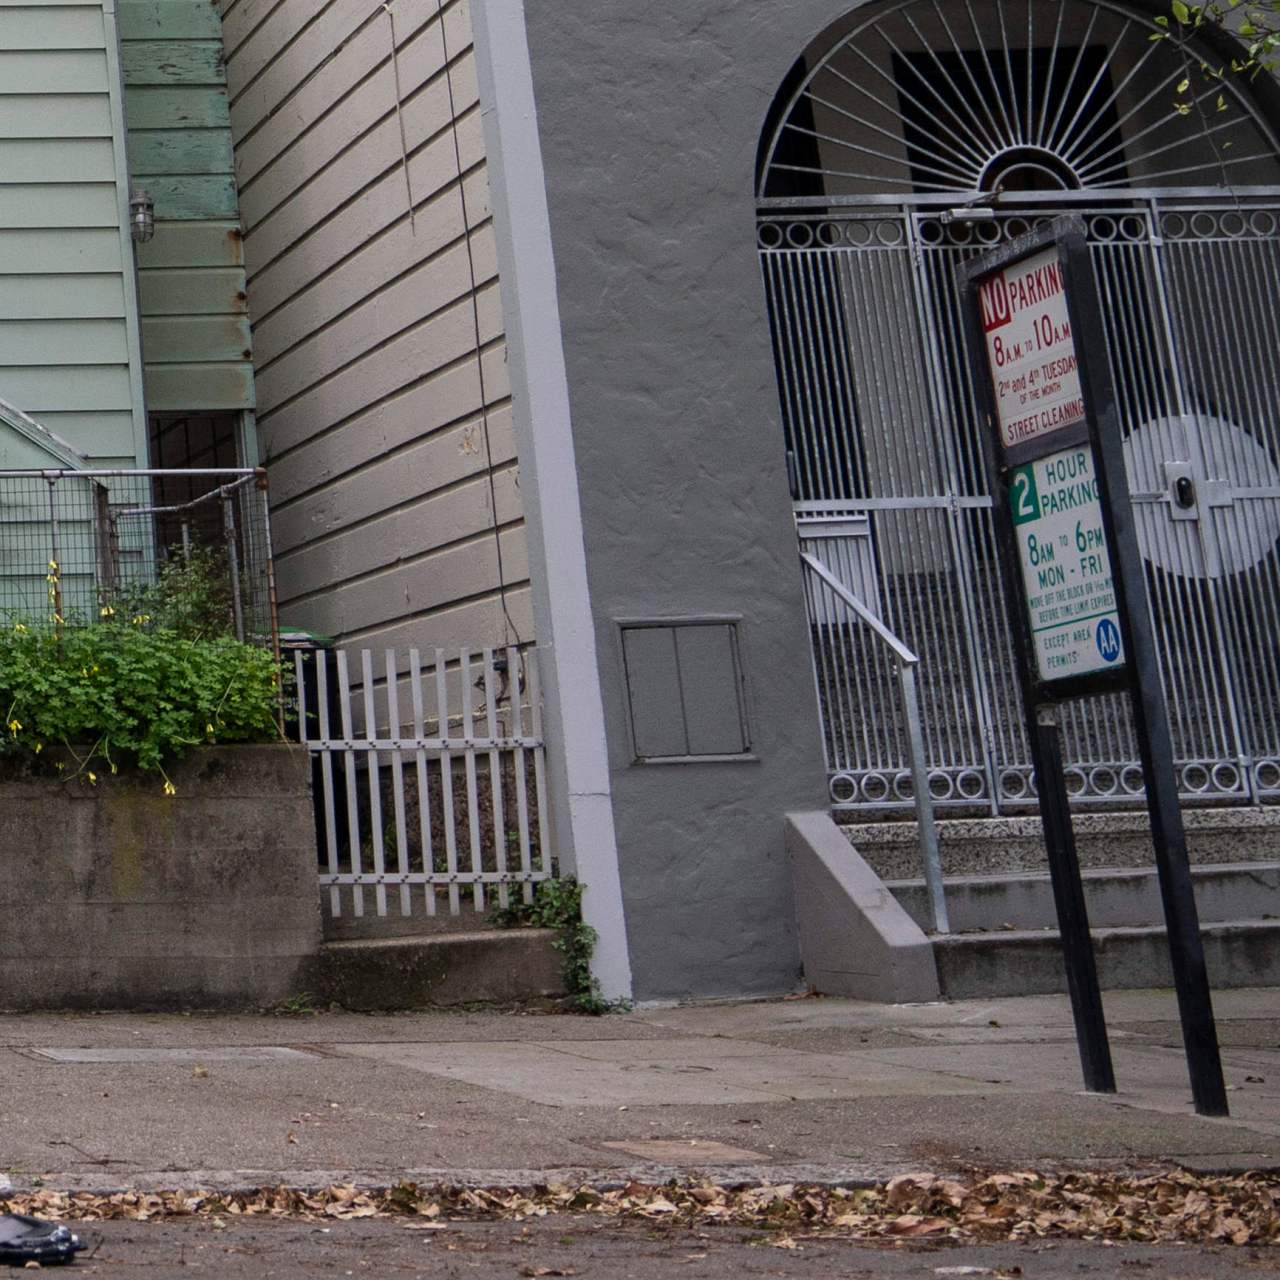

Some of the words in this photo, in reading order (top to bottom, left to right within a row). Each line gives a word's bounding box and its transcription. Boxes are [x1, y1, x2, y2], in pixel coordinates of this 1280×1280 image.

[981, 276, 1008, 327] NO
[1008, 261, 1065, 313] PARKING
[1024, 340, 1033, 352] TO
[1012, 375, 1027, 393] and
[1041, 355, 1079, 380] TUESDAY
[1020, 394, 1027, 405] OF
[1029, 389, 1040, 400] THE
[1042, 382, 1062, 397] MONTH
[1007, 414, 1040, 440] STREET
[1041, 398, 1084, 429] CLEANING
[1045, 452, 1088, 485] HOUR
[1014, 472, 1034, 517] 2
[1059, 534, 1068, 547] TO
[1038, 565, 1065, 589] MON
[1080, 554, 1103, 577] FRI
[1044, 632, 1069, 650] EXCEPT
[1073, 627, 1091, 641] AREA
[1100, 623, 1118, 655] AA
[1047, 651, 1078, 669] PERMITS
